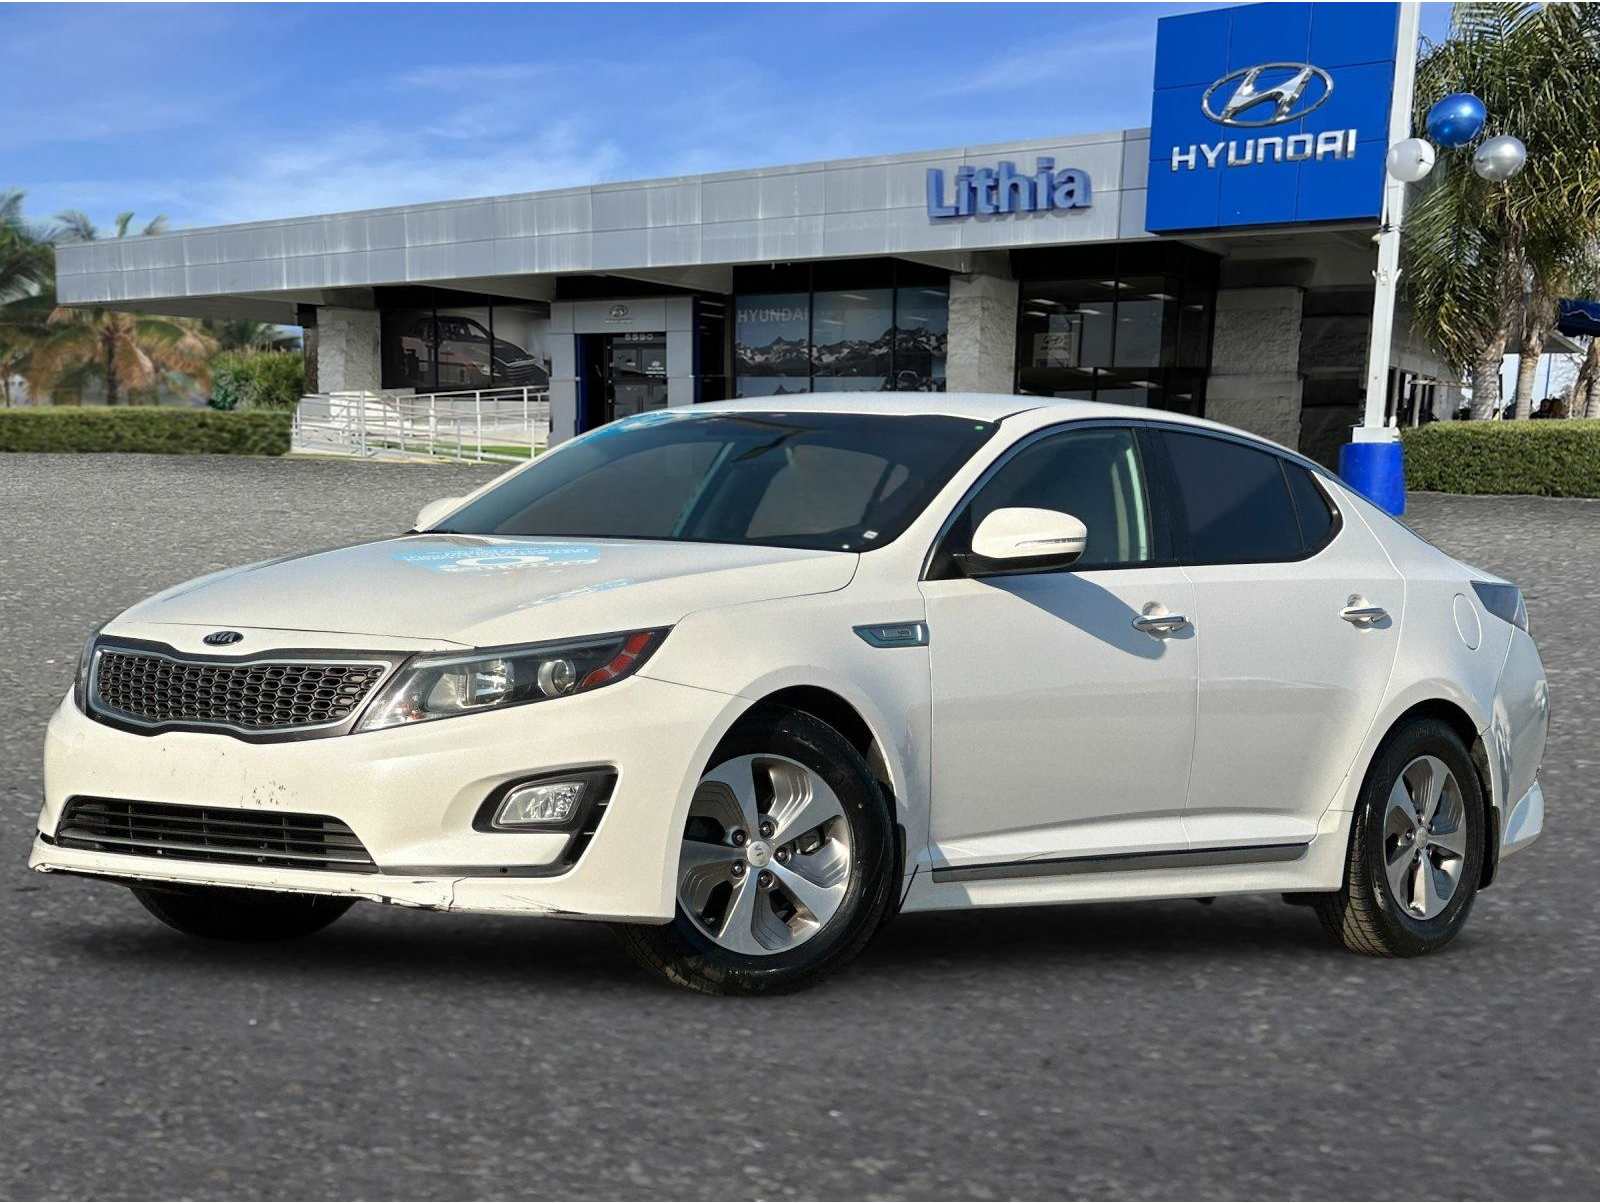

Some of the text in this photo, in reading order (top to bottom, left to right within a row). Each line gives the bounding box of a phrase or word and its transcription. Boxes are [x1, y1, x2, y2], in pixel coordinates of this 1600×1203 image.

[1171, 128, 1357, 172] HYUNDAI
[926, 156, 1092, 219] Lithia
[736, 306, 808, 323] HYUNDAI
